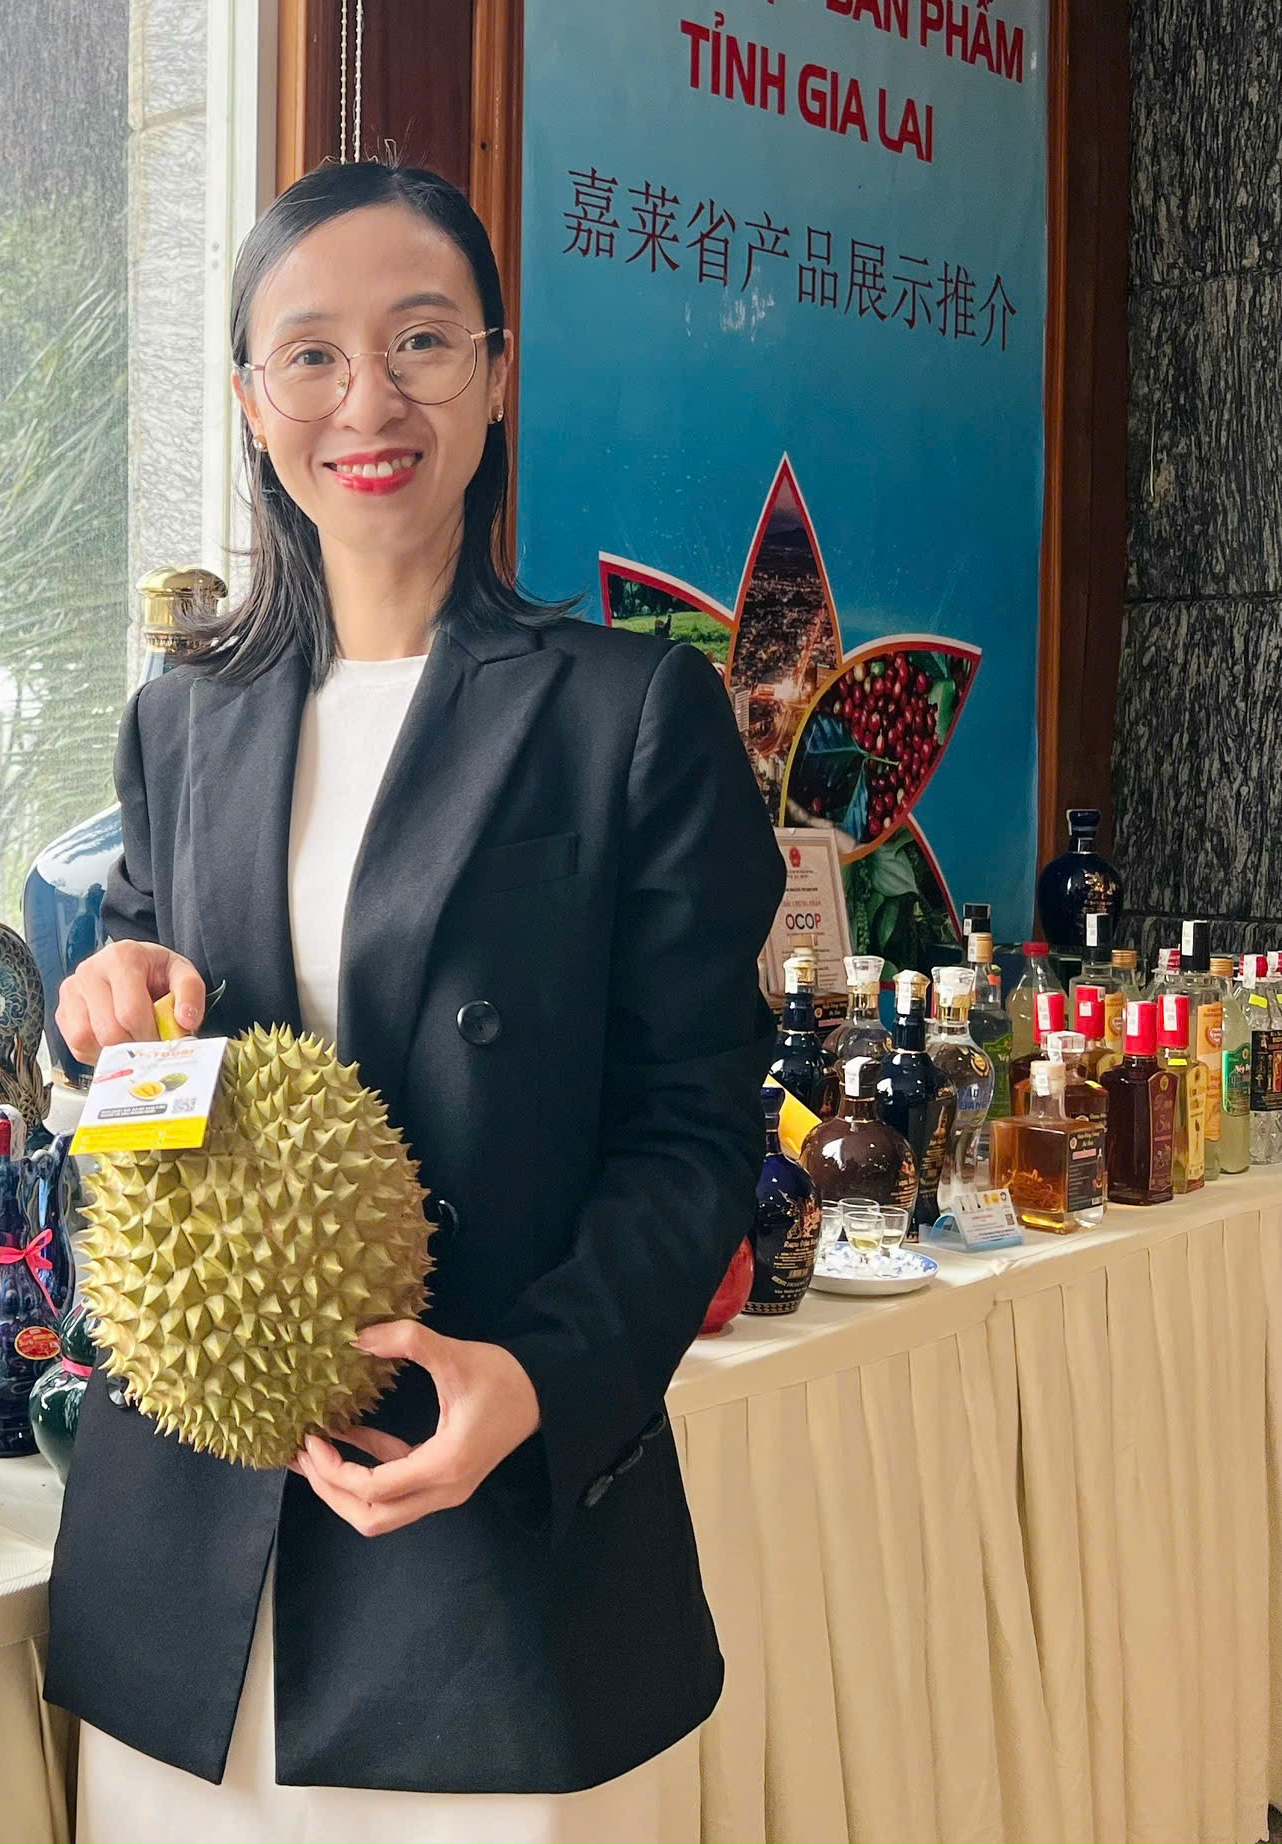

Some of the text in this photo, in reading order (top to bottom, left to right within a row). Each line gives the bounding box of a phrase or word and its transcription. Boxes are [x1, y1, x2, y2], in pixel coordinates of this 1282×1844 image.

[680, 11, 934, 164] TỈNH GIA LAI
[562, 166, 1017, 352] 嘉莱省产品展示推介
[785, 912, 822, 930] OCOP
